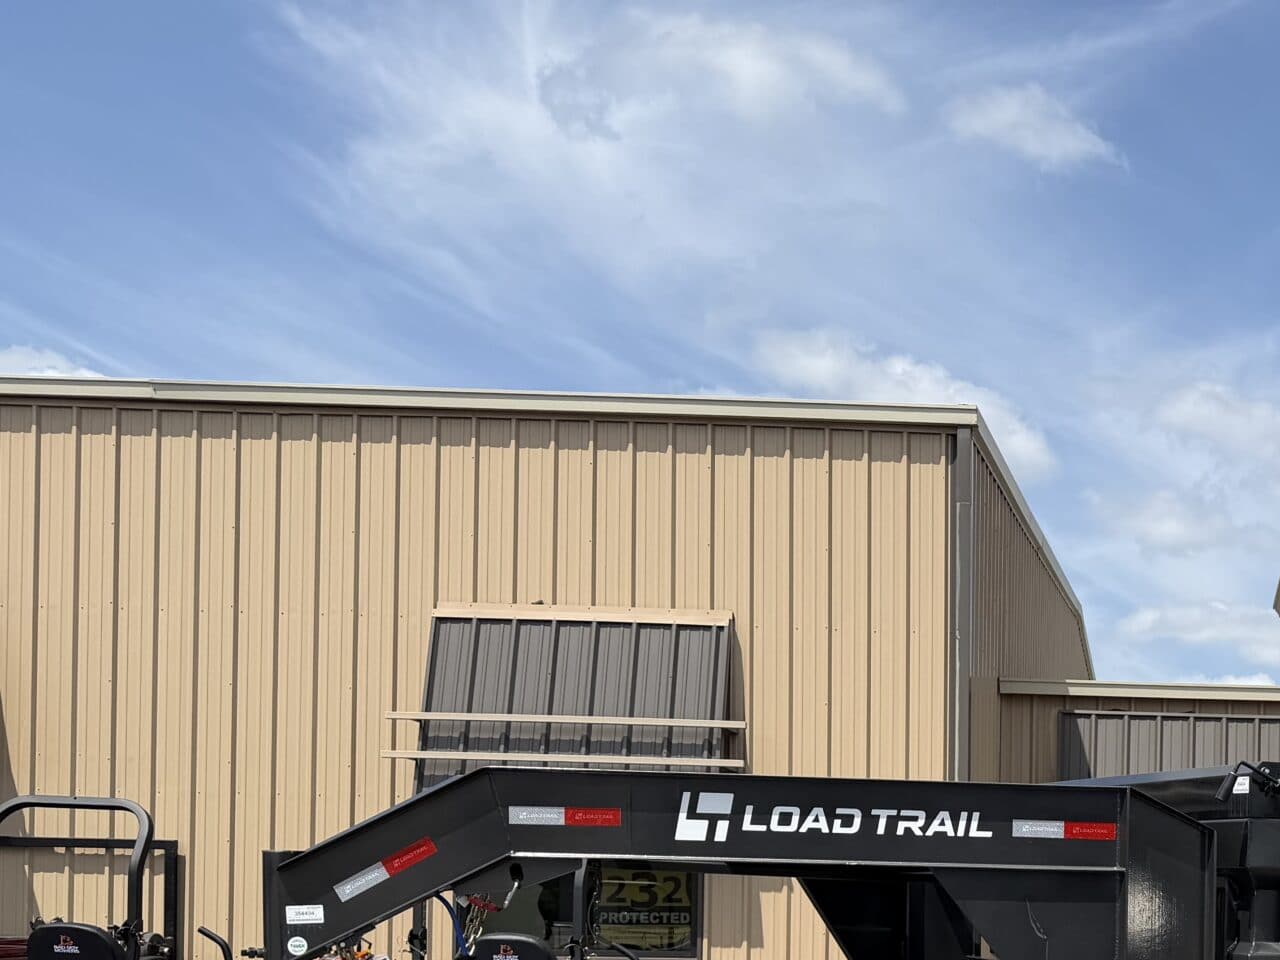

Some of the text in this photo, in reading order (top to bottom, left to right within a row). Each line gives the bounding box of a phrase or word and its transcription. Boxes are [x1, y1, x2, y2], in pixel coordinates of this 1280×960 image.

[742, 805, 993, 838] LOAD TRAIL
[606, 871, 683, 910] 232
[600, 912, 690, 924] PROTECTED
